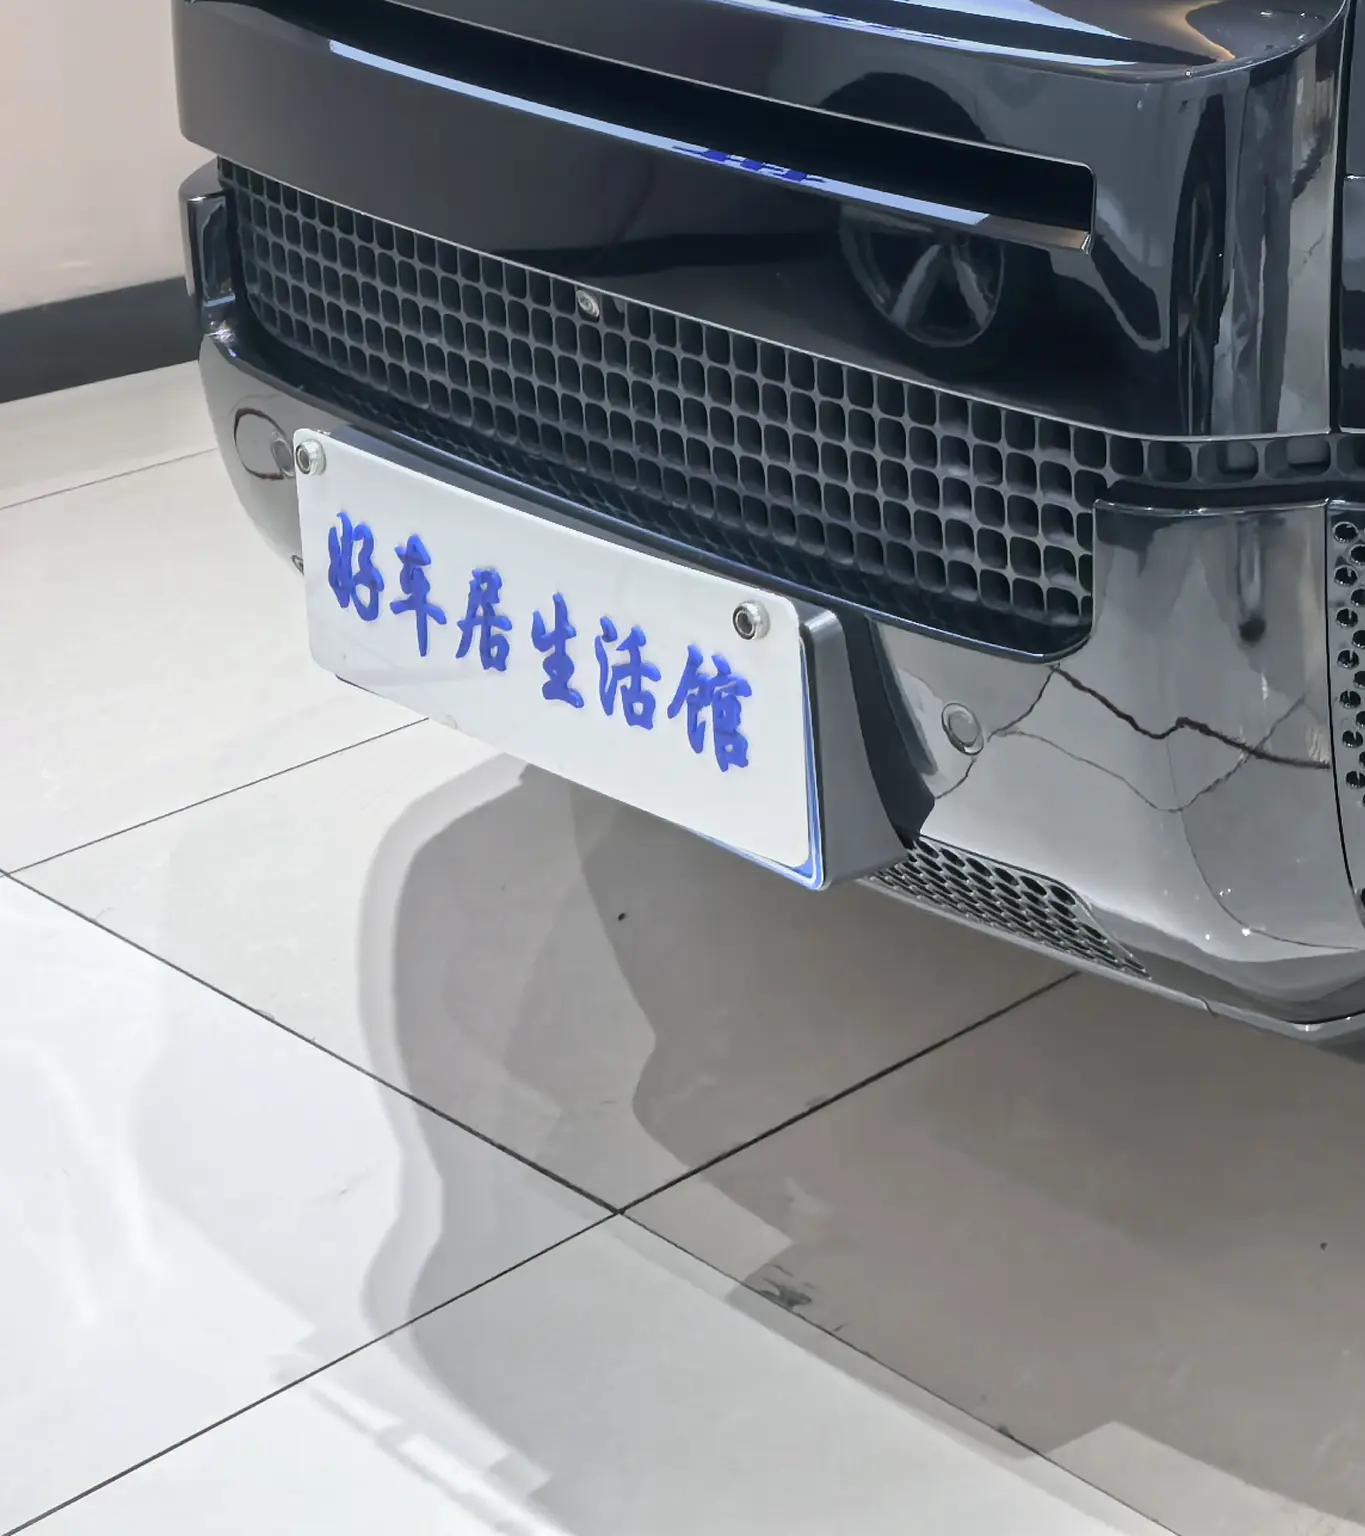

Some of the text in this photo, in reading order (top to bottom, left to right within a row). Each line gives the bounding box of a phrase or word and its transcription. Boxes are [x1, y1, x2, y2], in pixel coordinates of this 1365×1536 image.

[327, 510, 752, 772] 好车居生活馆
